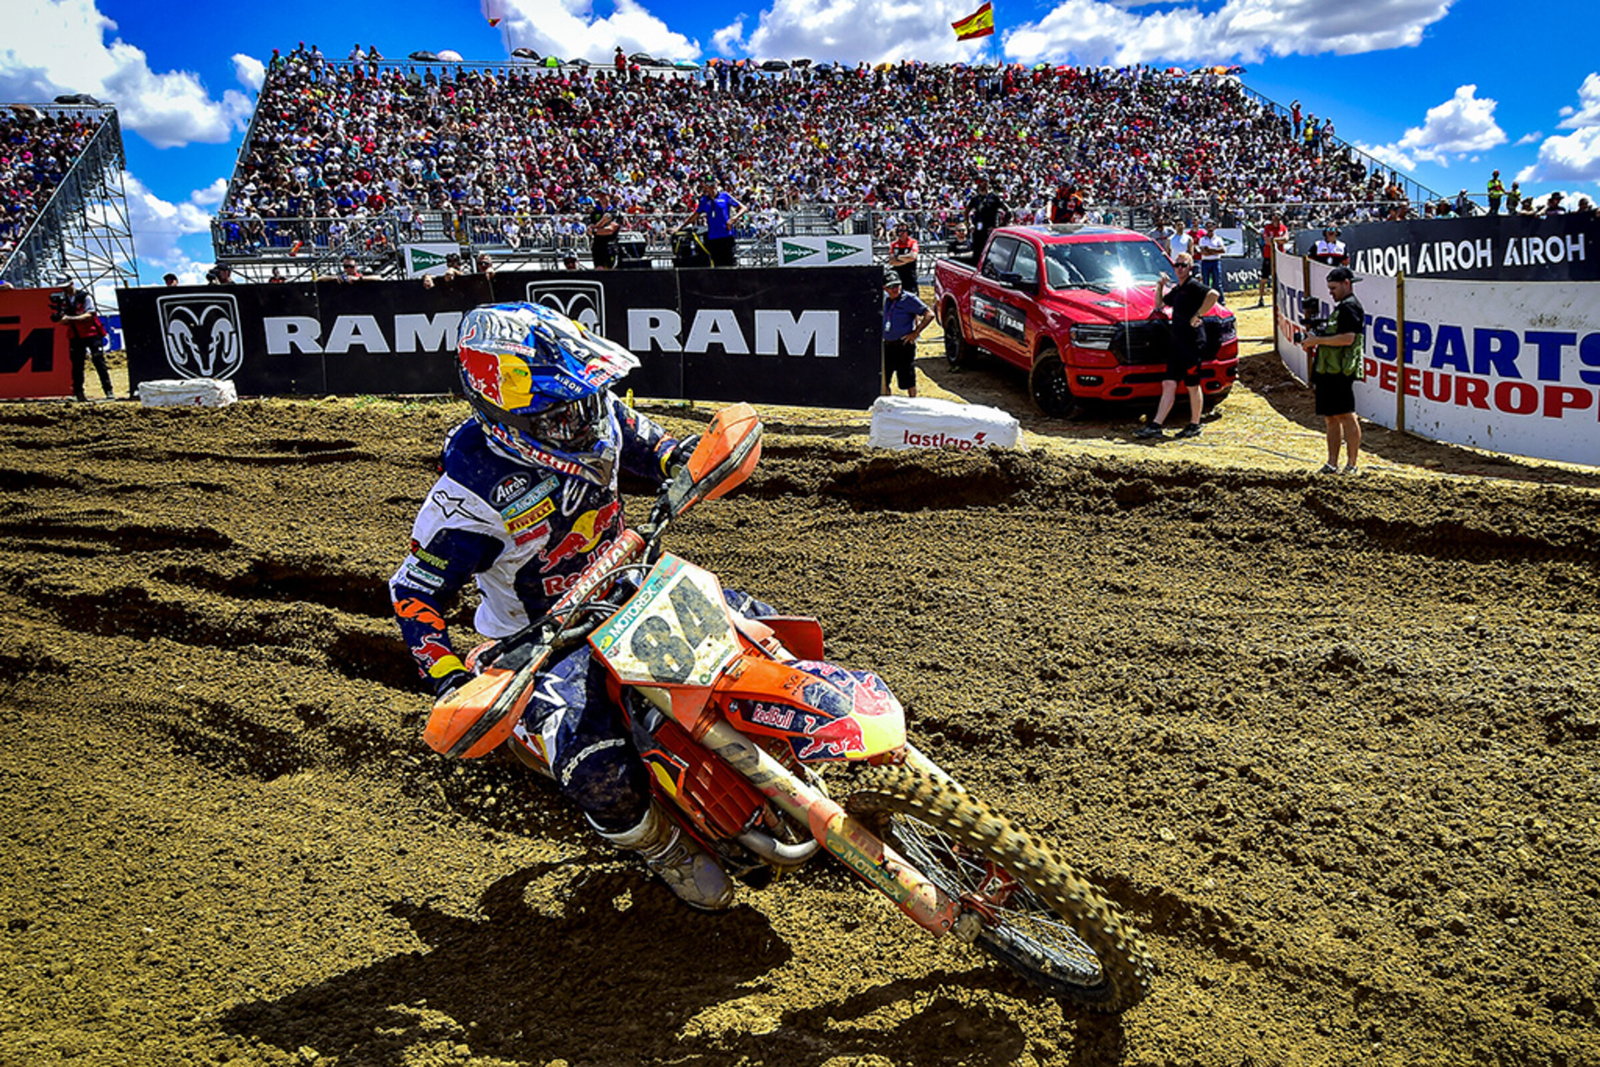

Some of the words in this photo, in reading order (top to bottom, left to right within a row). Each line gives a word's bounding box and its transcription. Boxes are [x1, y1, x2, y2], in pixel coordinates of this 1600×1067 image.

[1355, 244, 1411, 277] AIROH
[1416, 238, 1493, 274] AIROH
[1503, 233, 1586, 267] AIROH
[263, 312, 463, 355] RAM
[627, 309, 840, 357] RAM
[903, 429, 972, 452] lastlap
[496, 475, 528, 503] Airoh
[608, 584, 658, 639] MOTOREX
[630, 575, 731, 684] 84
[842, 849, 906, 900] MOTOREX
